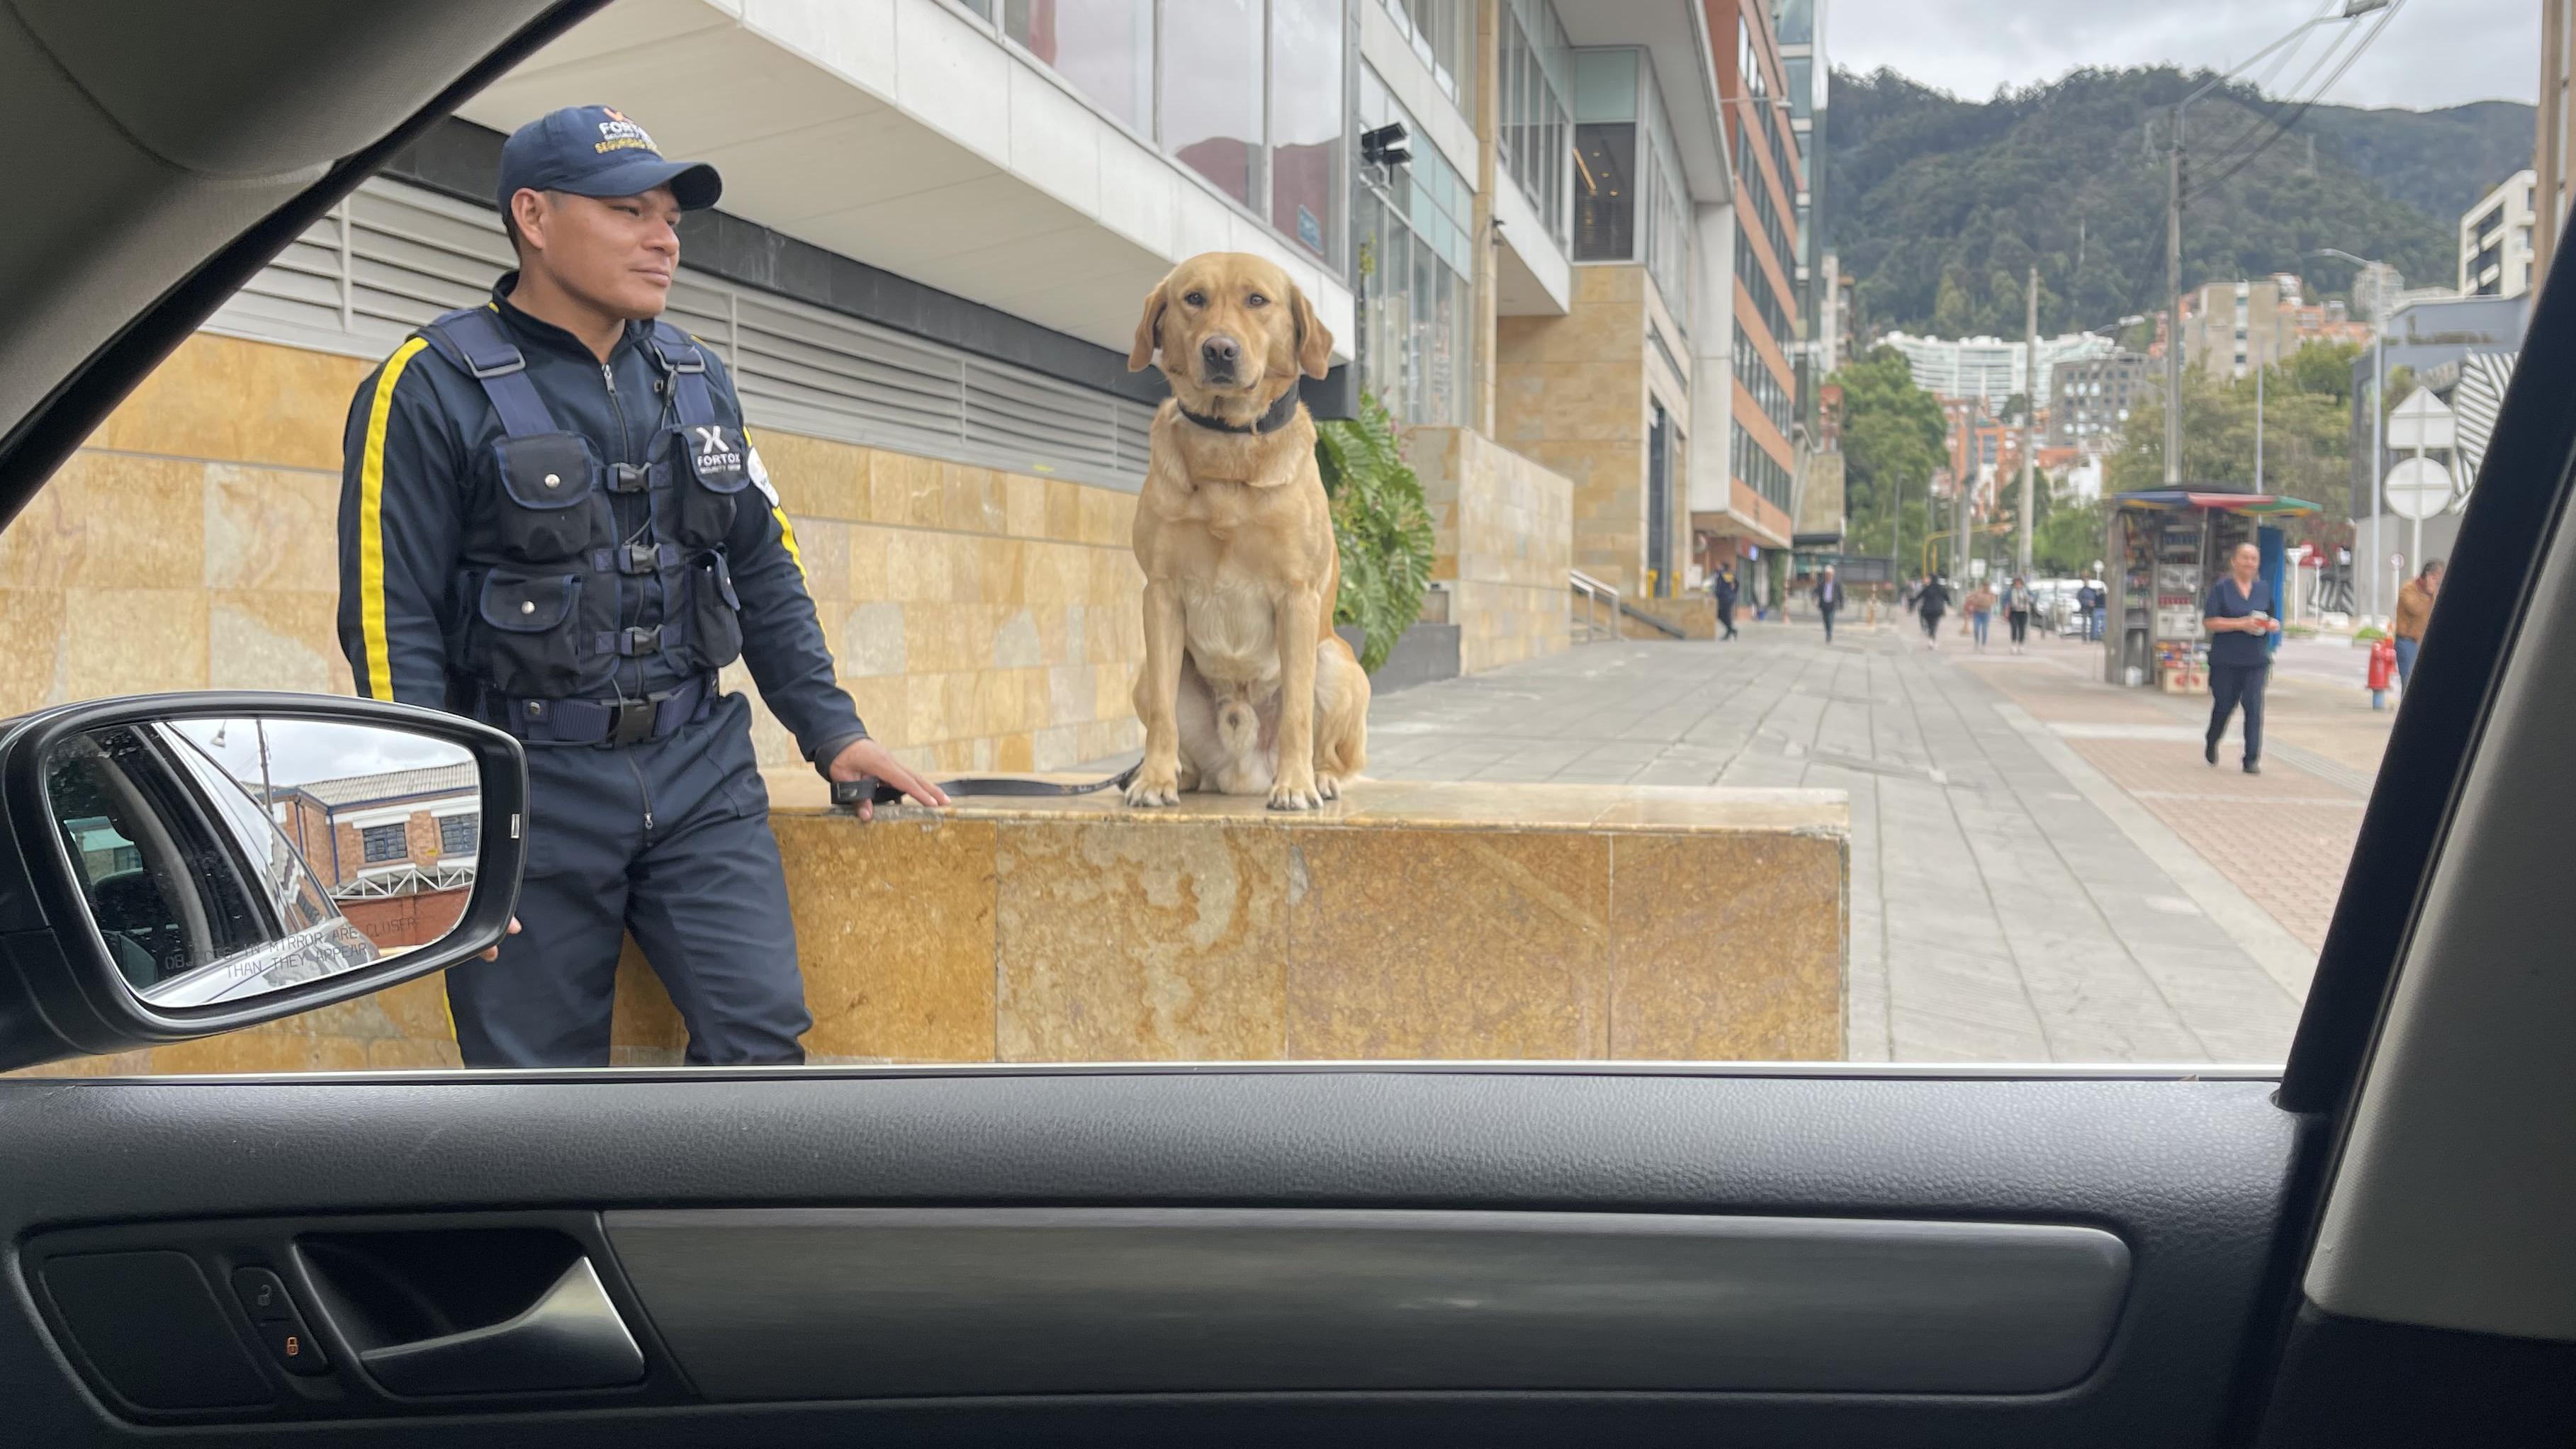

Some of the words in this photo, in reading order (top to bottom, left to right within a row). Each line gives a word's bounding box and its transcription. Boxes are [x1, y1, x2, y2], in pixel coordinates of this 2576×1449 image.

[697, 453, 741, 468] FORTOX
[269, 932, 324, 952] MIRROR
[332, 927, 358, 941] ARE
[366, 917, 418, 937] CLOSER
[227, 960, 262, 978] THAN
[272, 953, 306, 970] THEY
[315, 942, 367, 963] APPEAR
